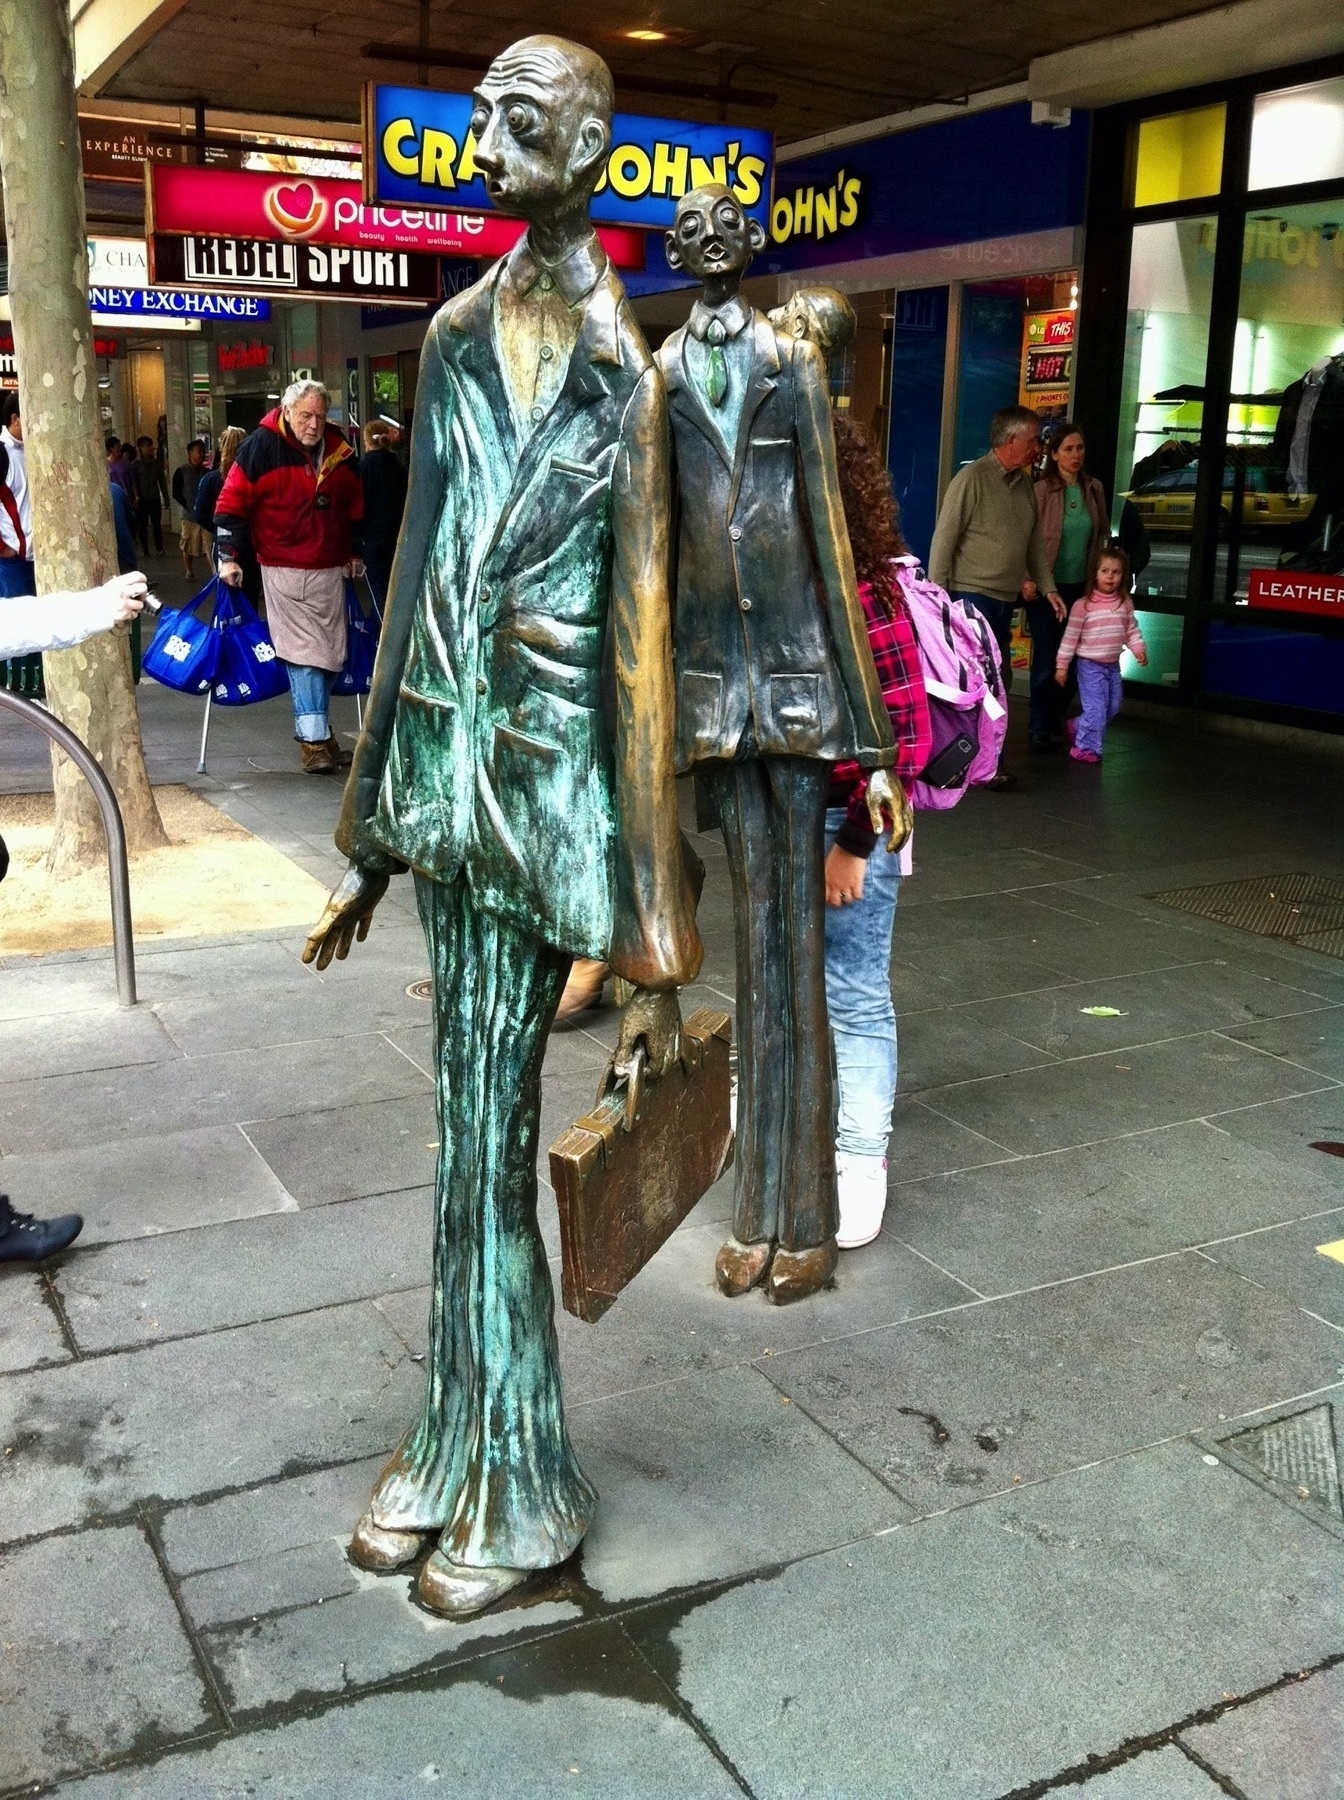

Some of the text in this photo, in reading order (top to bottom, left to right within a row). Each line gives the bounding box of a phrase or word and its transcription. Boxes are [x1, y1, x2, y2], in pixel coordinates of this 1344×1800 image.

[86, 140, 172, 157] EXPERIENCE
[359, 231, 462, 247] beauty health wellbeing
[194, 237, 291, 279] REBEL
[142, 290, 258, 316] EXCHANGE
[1051, 321, 1073, 337] THIS
